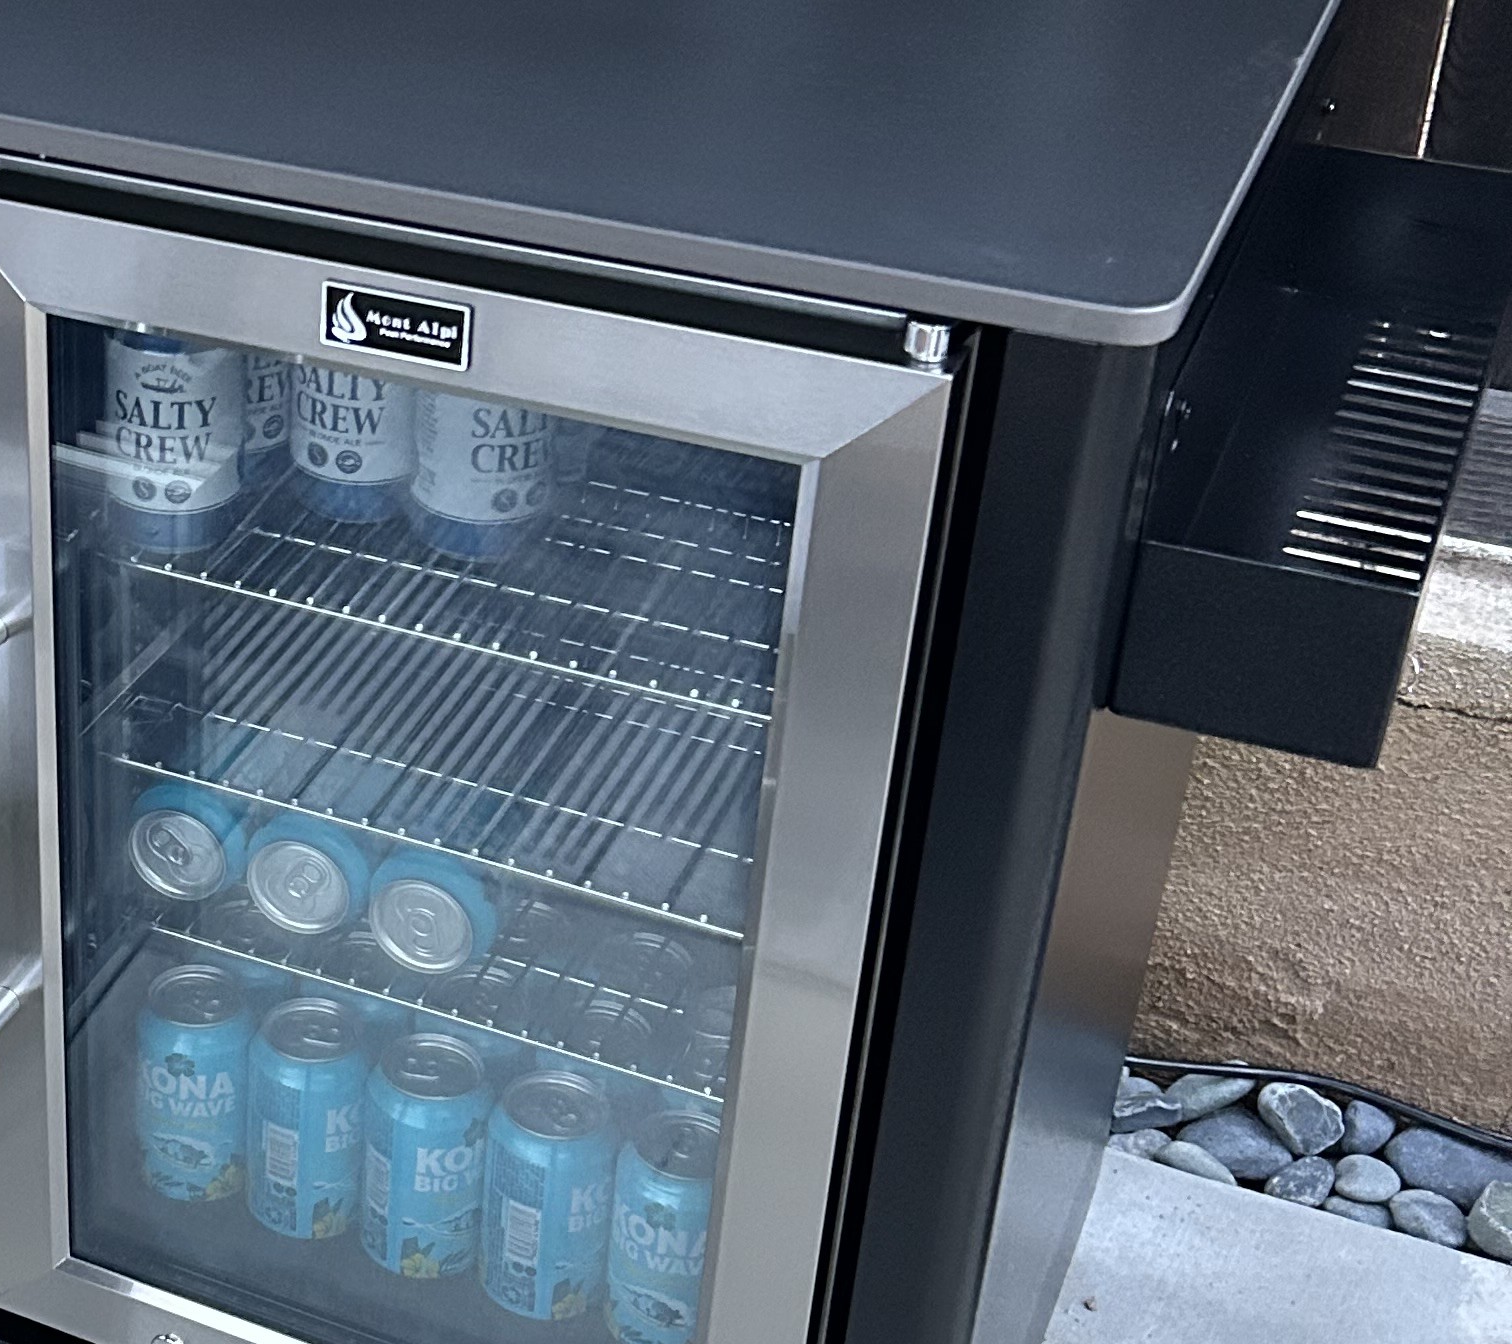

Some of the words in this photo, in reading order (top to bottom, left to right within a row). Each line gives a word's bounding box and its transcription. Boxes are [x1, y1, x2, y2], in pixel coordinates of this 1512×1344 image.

[365, 309, 411, 331] Mont
[416, 319, 458, 340] Alpi
[115, 389, 217, 431] SALTY
[297, 390, 386, 436] CREW
[115, 425, 213, 465] CREW
[167, 1094, 237, 1119] WAVE
